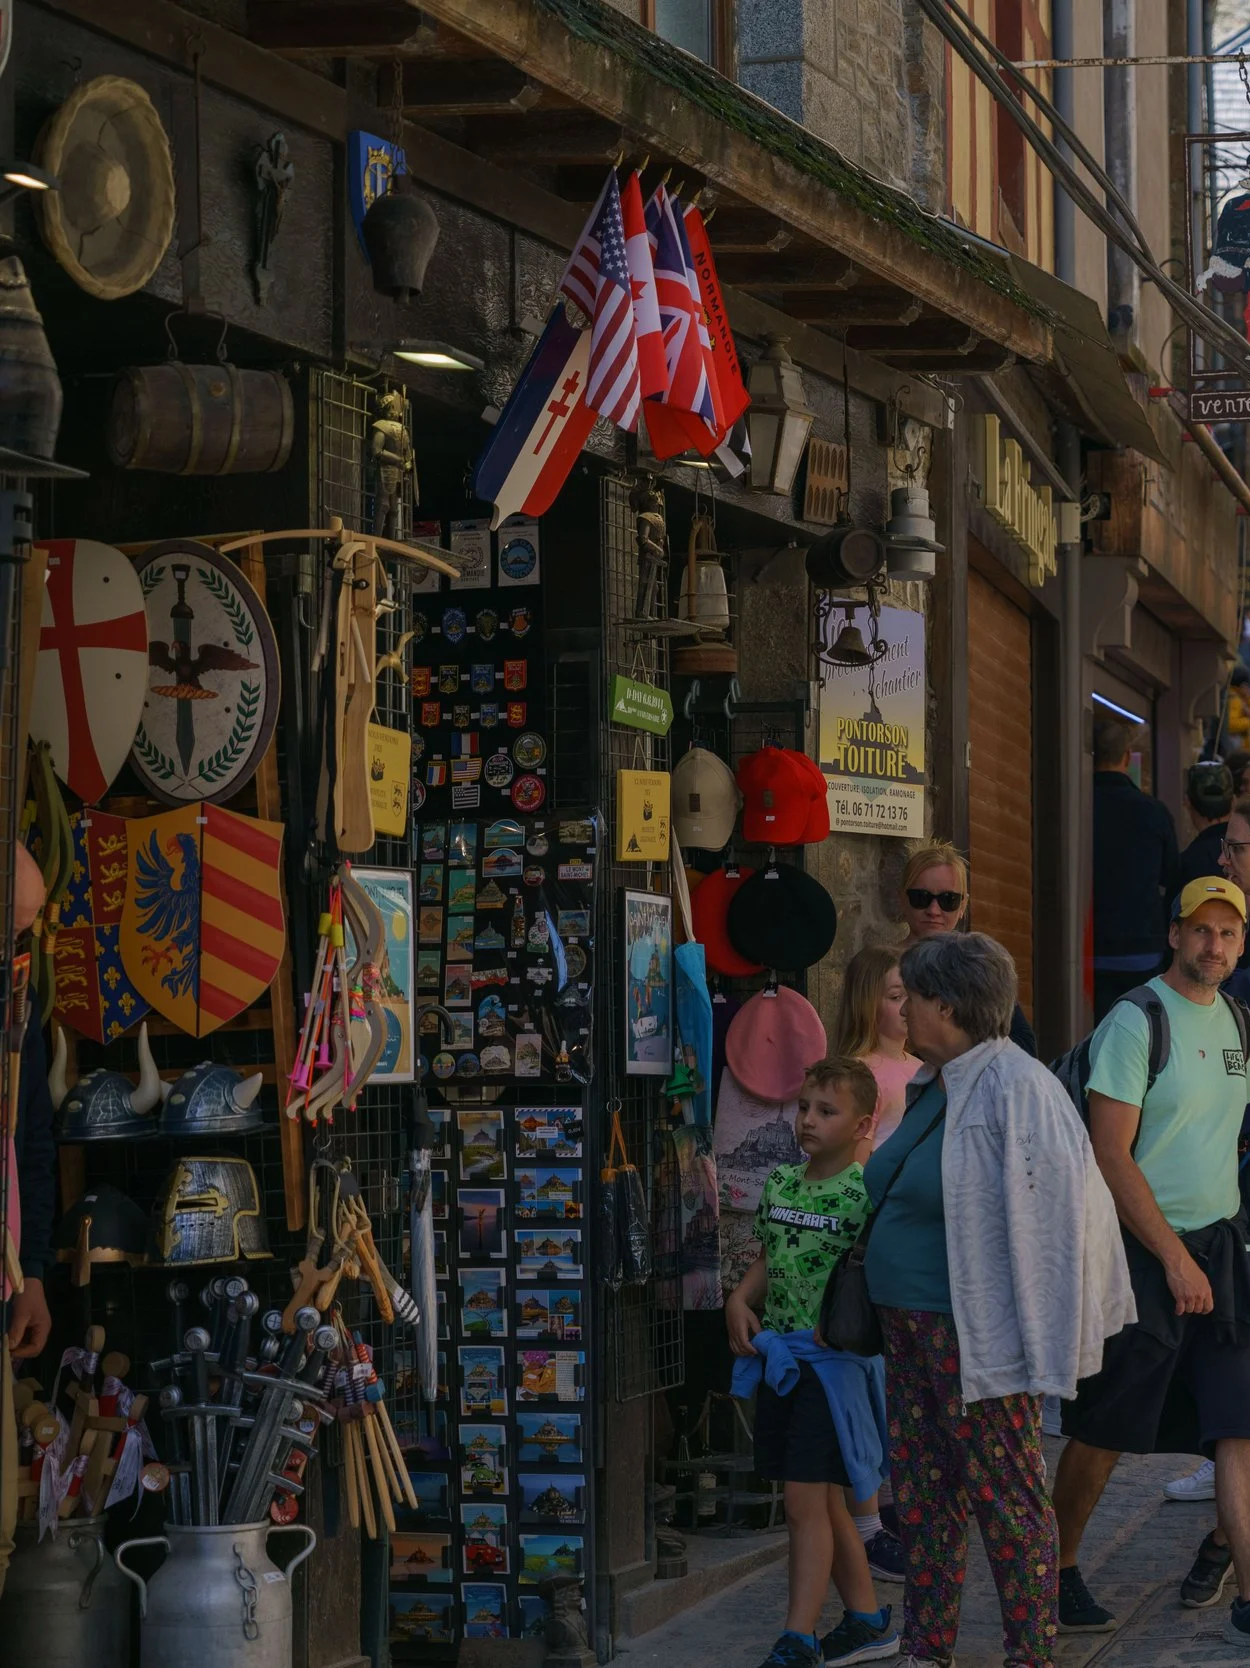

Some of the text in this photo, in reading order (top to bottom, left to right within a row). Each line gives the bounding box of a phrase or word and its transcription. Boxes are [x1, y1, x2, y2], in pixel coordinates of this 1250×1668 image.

[694, 251, 737, 377] NORMANDIE
[876, 667, 921, 700] chantier
[836, 717, 908, 748] PONTORSON
[837, 743, 907, 779] TOITURE
[828, 781, 916, 799] COUVERTURE, ISOLATION, RAMONAGE
[835, 800, 908, 821] Tél. 06 71 72 13 76
[767, 1205, 840, 1234] MINECRAFT
